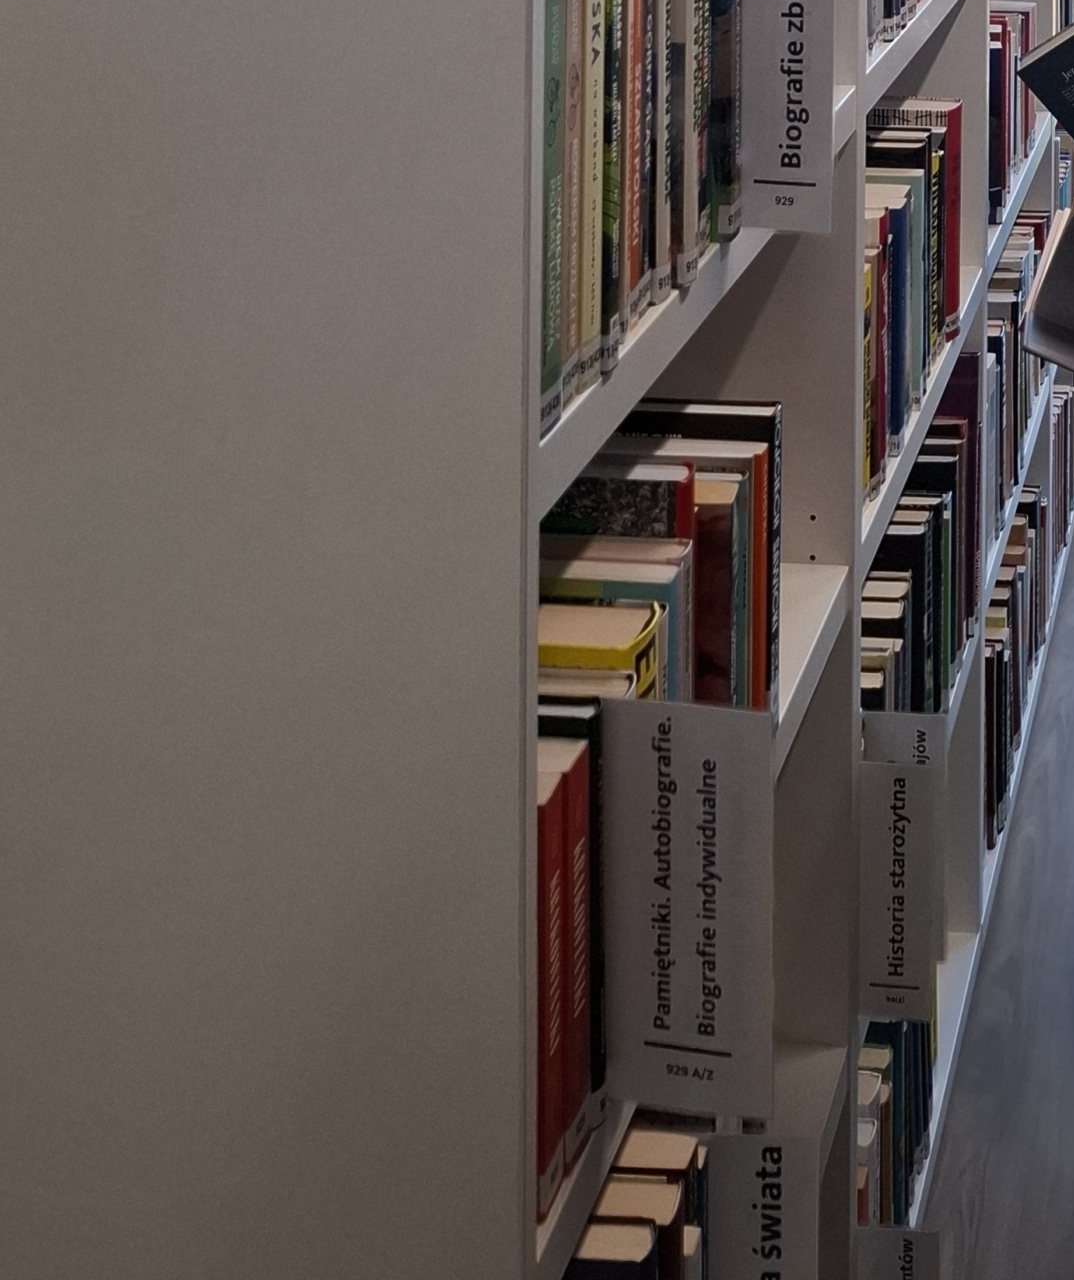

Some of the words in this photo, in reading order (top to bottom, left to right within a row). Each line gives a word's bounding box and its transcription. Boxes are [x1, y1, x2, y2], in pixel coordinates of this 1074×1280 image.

[634, 62, 642, 149] SZLAKI
[778, 40, 809, 170] Biografie
[632, 157, 641, 246] POLSKI
[774, 196, 795, 206] 929
[650, 716, 677, 892] Autobiografie.
[694, 759, 721, 922] indywidualne
[887, 777, 911, 888] starożytna
[650, 898, 676, 1033] Pamiętniki.
[694, 927, 721, 1038] Biografie
[887, 896, 906, 978] Historia
[666, 1063, 689, 1076] 929
[692, 1067, 715, 1081] A/Z
[752, 1146, 782, 1260] świata
